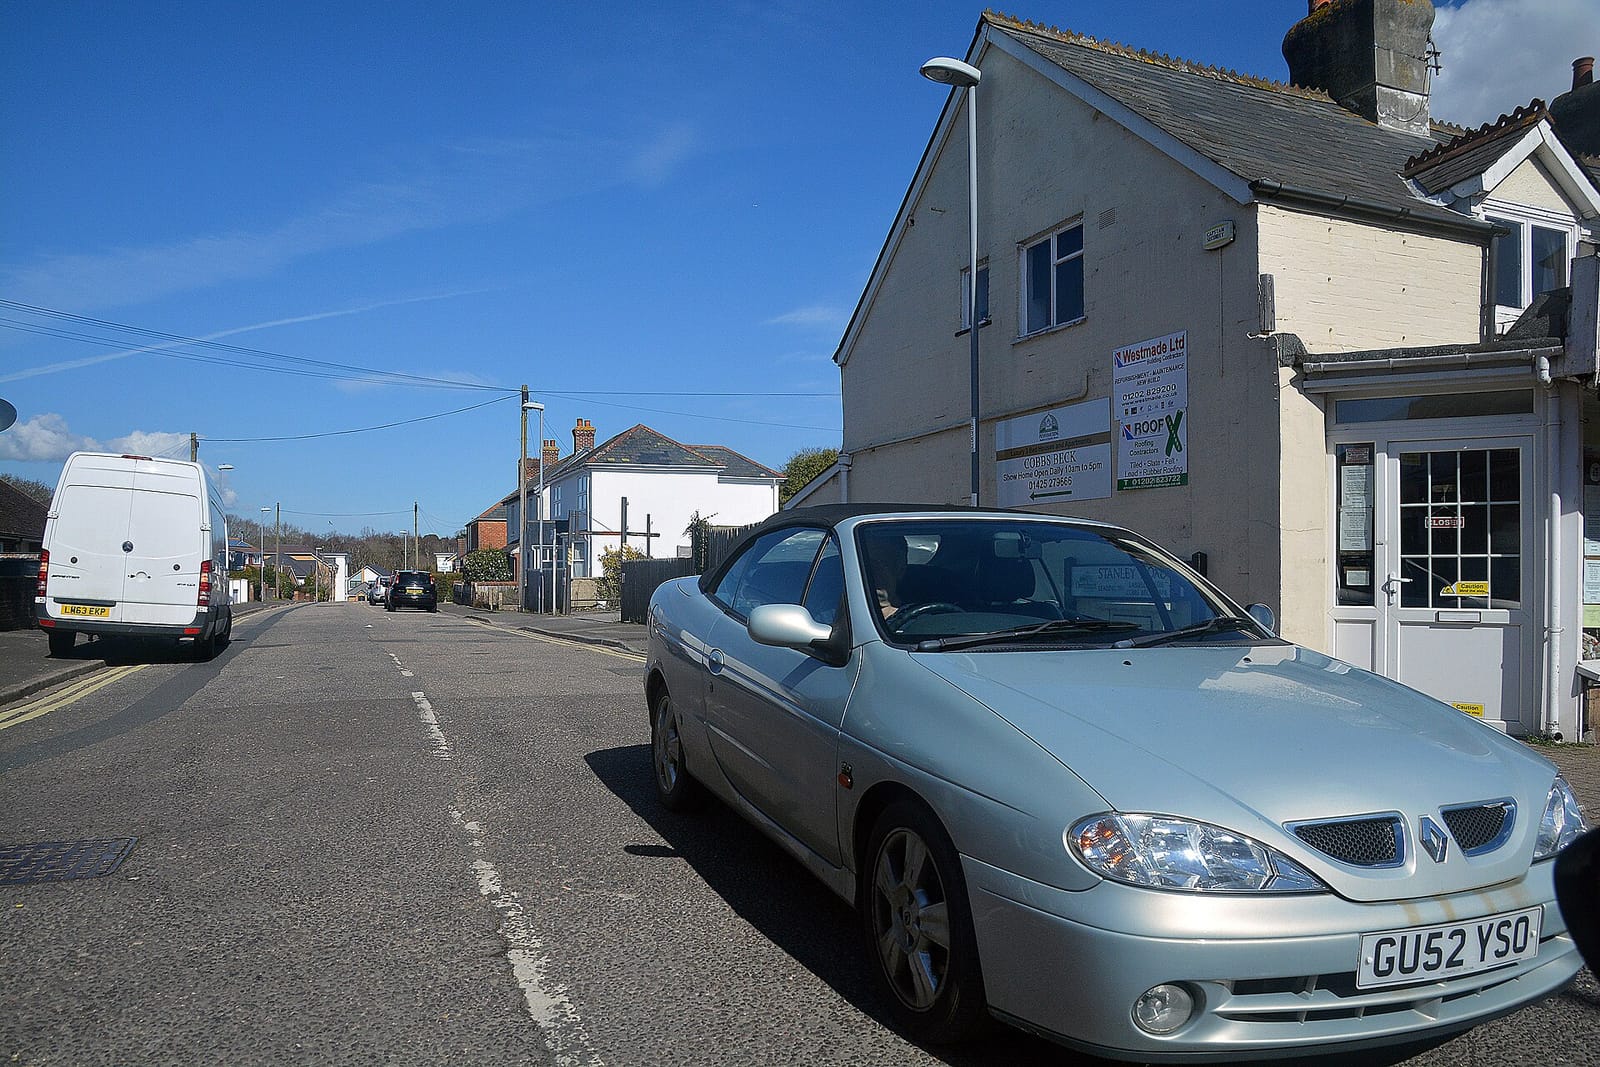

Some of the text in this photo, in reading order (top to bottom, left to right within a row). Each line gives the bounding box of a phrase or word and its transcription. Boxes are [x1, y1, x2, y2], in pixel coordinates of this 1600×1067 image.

[1122, 335, 1185, 363] Westmade Ltd
[1147, 352, 1184, 365] Building Contractors
[1152, 363, 1185, 376] MAINTENANCE
[1122, 391, 1144, 401] 01202
[1134, 440, 1154, 448] Roofing
[1129, 448, 1158, 456] Contractors
[1024, 450, 1077, 469] COBBS BECK
[1003, 473, 1017, 481] Show
[1018, 471, 1033, 480] Home
[1034, 469, 1049, 479] Open
[1050, 467, 1064, 476] Daily
[1065, 464, 1080, 473] 10am
[1142, 467, 1162, 476] Rubber
[1163, 465, 1183, 474] Roofing
[1028, 479, 1047, 490] 01425
[1132, 477, 1154, 485] 01202
[1098, 567, 1136, 580] STANLEY
[89, 607, 106, 615] EKP
[1373, 916, 1530, 977] GU52 YSO
